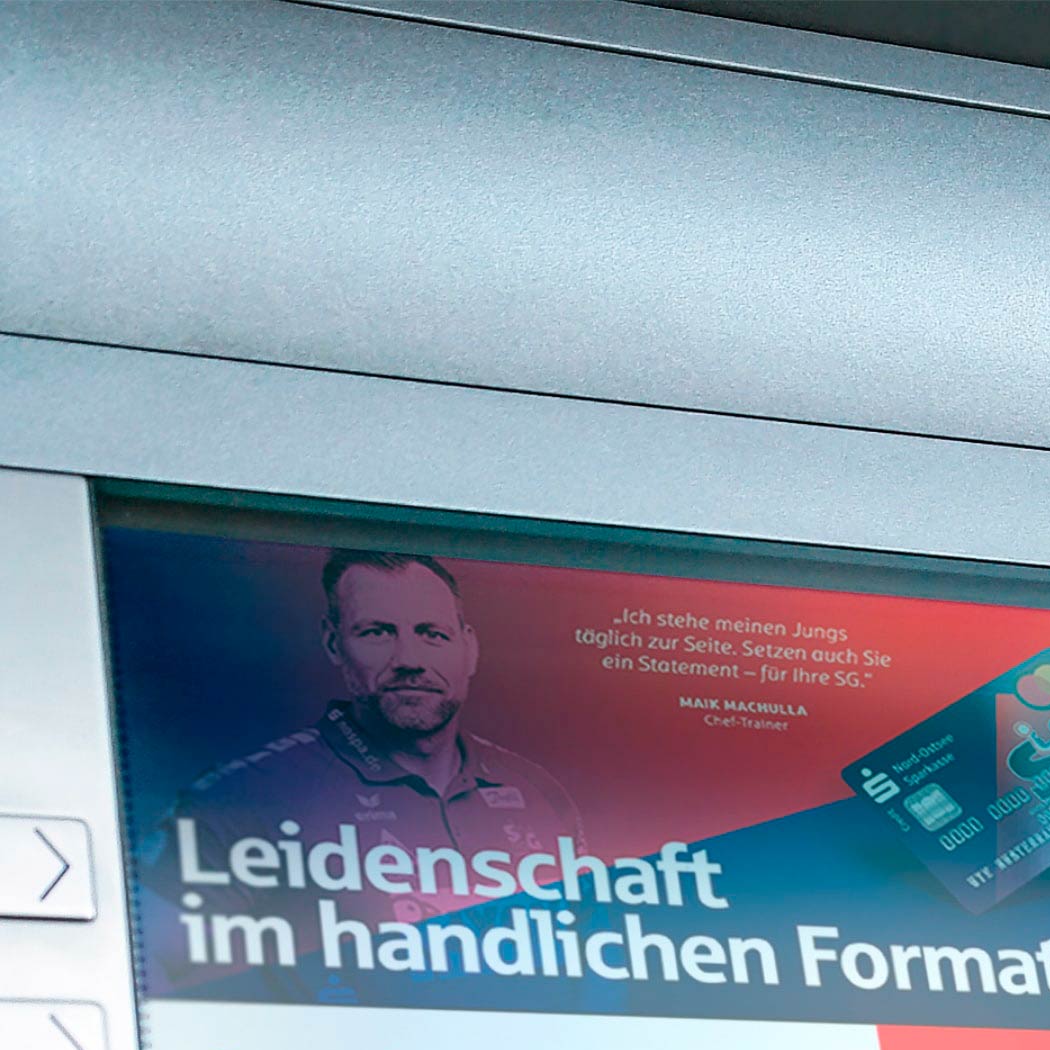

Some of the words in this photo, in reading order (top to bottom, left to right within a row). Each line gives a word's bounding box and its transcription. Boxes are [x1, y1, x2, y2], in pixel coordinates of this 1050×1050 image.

[657, 611, 710, 631] stehe
[715, 616, 787, 637] meinen
[792, 622, 849, 644] Jungs
[575, 628, 643, 649] täglich
[648, 635, 679, 650] zur
[684, 635, 738, 656] Seite.
[742, 640, 808, 661] Setzen
[811, 644, 858, 665] auch
[863, 650, 892, 668] Sie
[602, 653, 634, 671] ein
[638, 656, 739, 678] Statement
[760, 664, 787, 683] für
[792, 667, 831, 686] Ihre
[679, 696, 721, 711] MAIK
[724, 699, 808, 717] MACHULLA
[703, 714, 789, 731] Chef-Trainer
[176, 818, 729, 909] Leidenschaft
[180, 893, 297, 967] im
[318, 899, 780, 986] handlichen
